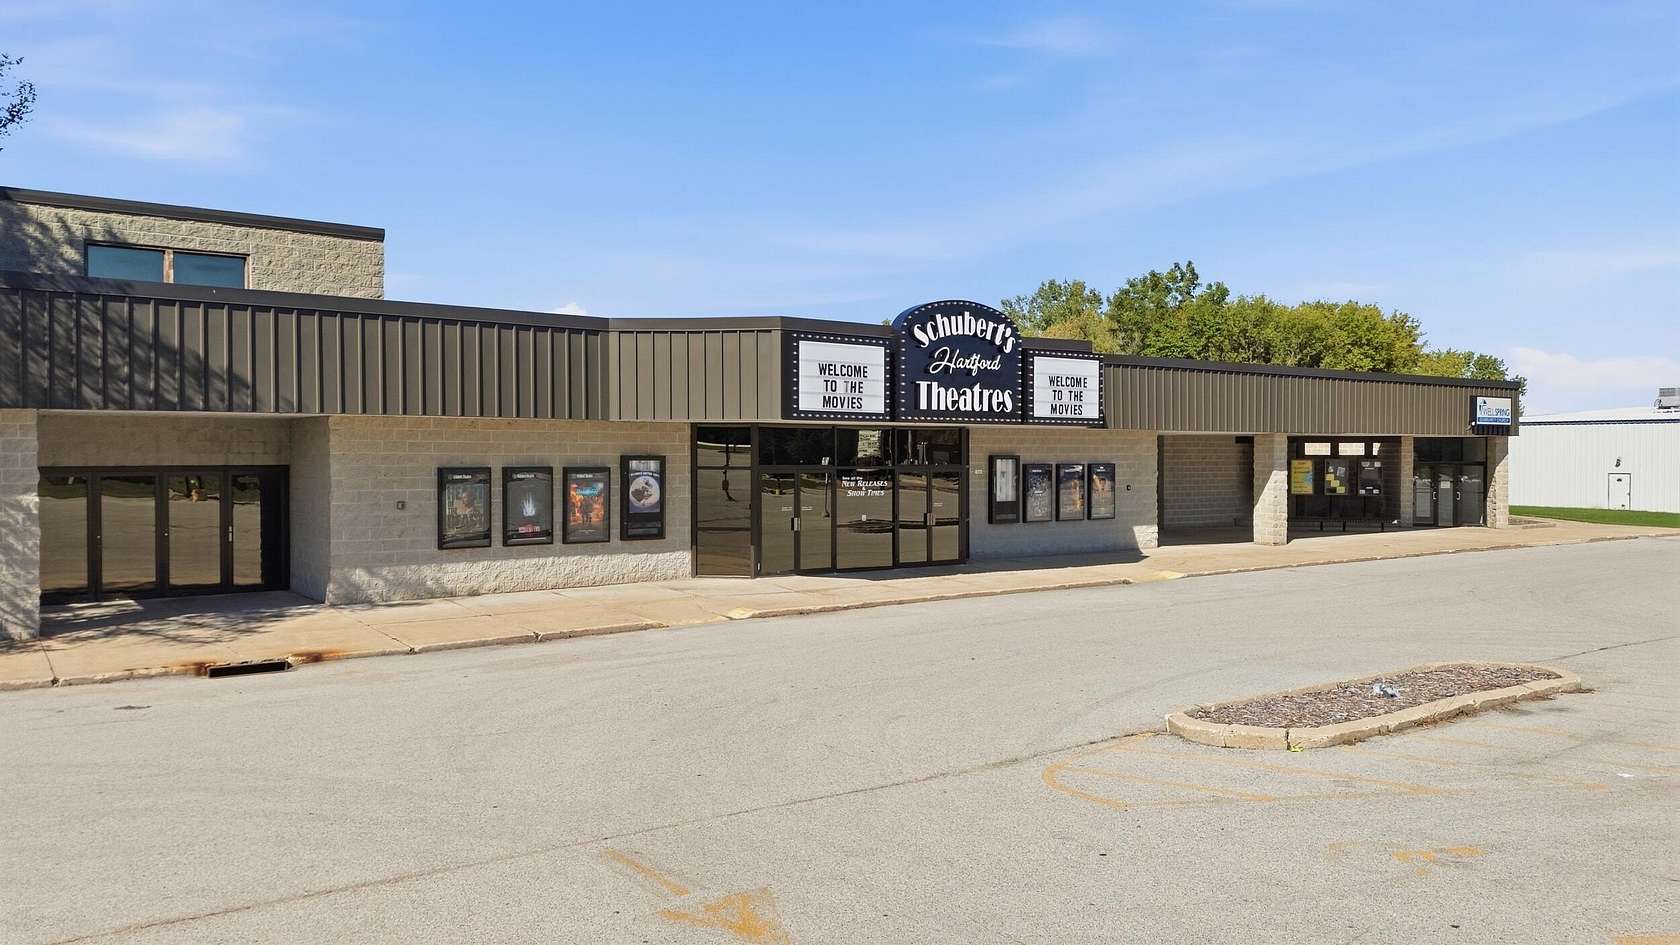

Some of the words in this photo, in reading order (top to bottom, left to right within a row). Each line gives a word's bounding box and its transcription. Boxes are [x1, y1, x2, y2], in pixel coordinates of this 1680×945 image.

[913, 311, 1016, 354] Schubert's
[929, 346, 1001, 377] Hartford
[818, 362, 868, 378] WELCOME
[823, 379, 837, 393] TO
[843, 380, 864, 394] THE
[1048, 375, 1088, 389] WELCOME
[822, 395, 863, 409] MOVIES
[915, 380, 1013, 413] Theatres
[1052, 389, 1063, 401] TO
[1068, 390, 1084, 402] THE
[1050, 403, 1083, 416] MOVIES
